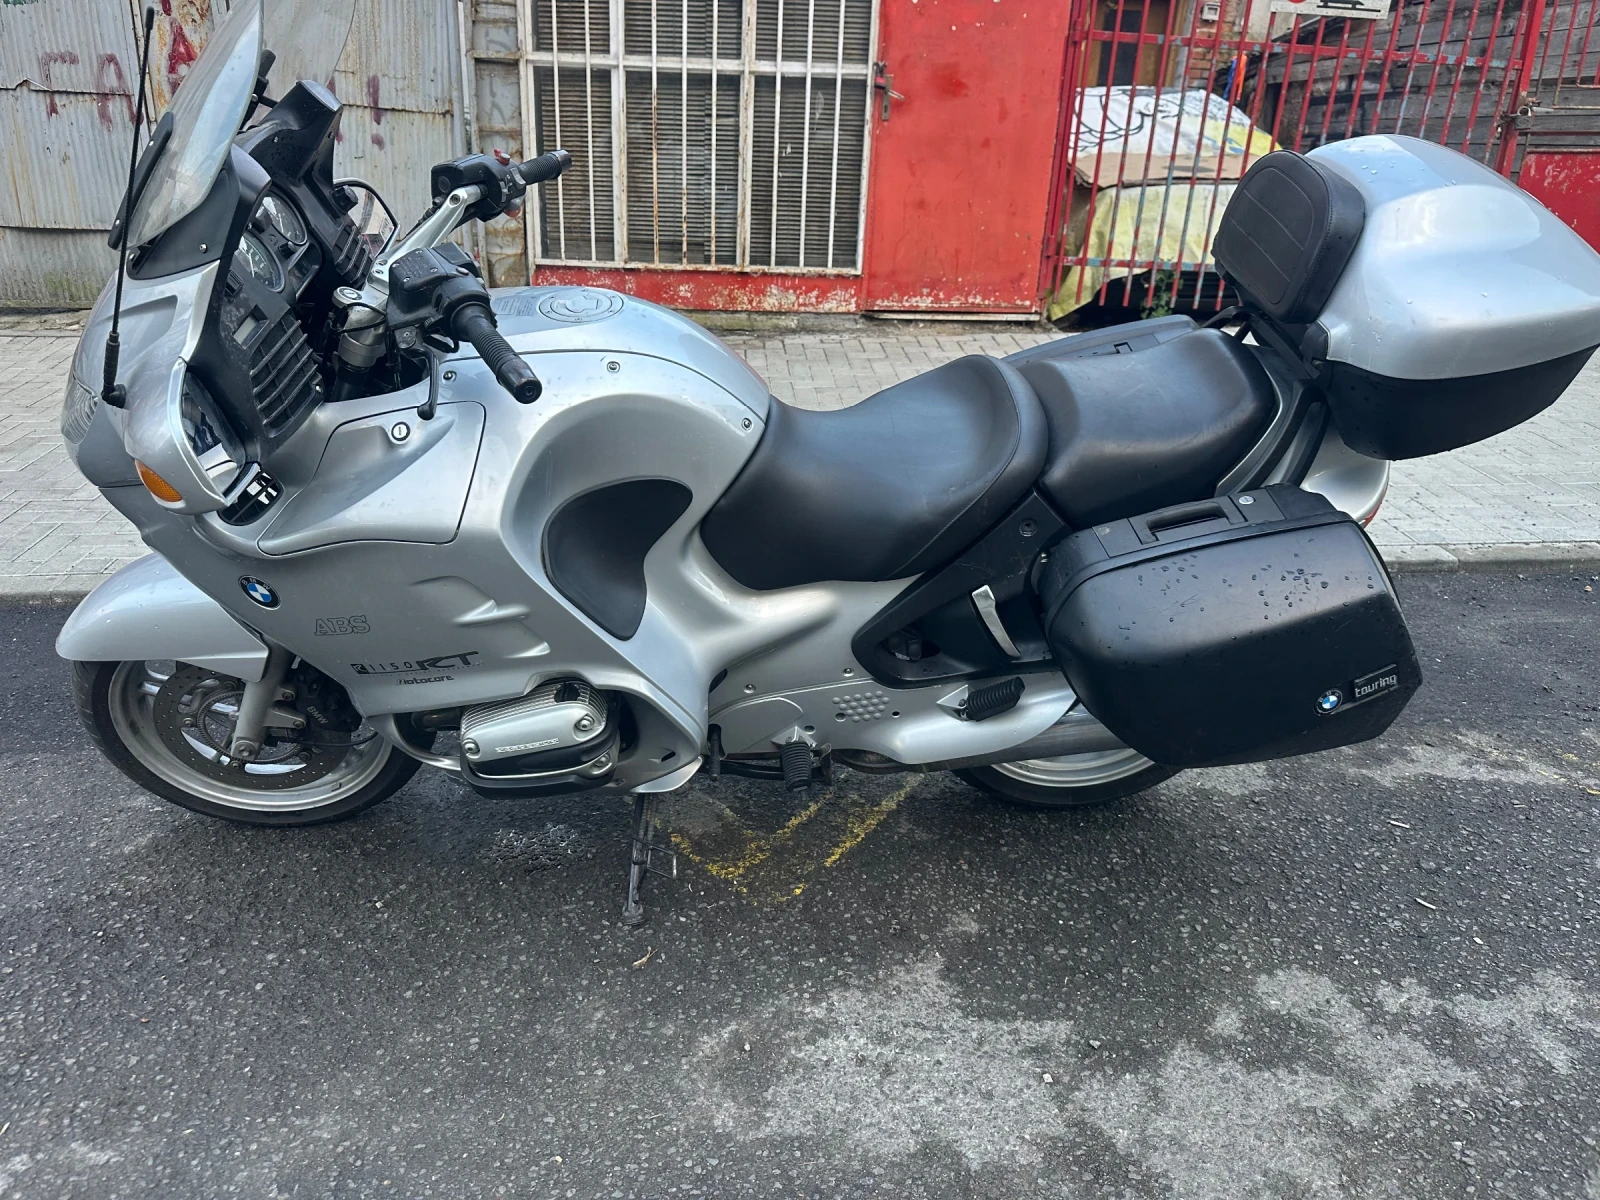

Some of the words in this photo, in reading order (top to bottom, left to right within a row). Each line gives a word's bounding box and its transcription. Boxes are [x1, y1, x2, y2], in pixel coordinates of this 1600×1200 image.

[314, 615, 370, 636] ABS
[1355, 674, 1397, 697] touring
[306, 705, 328, 723] BMW
